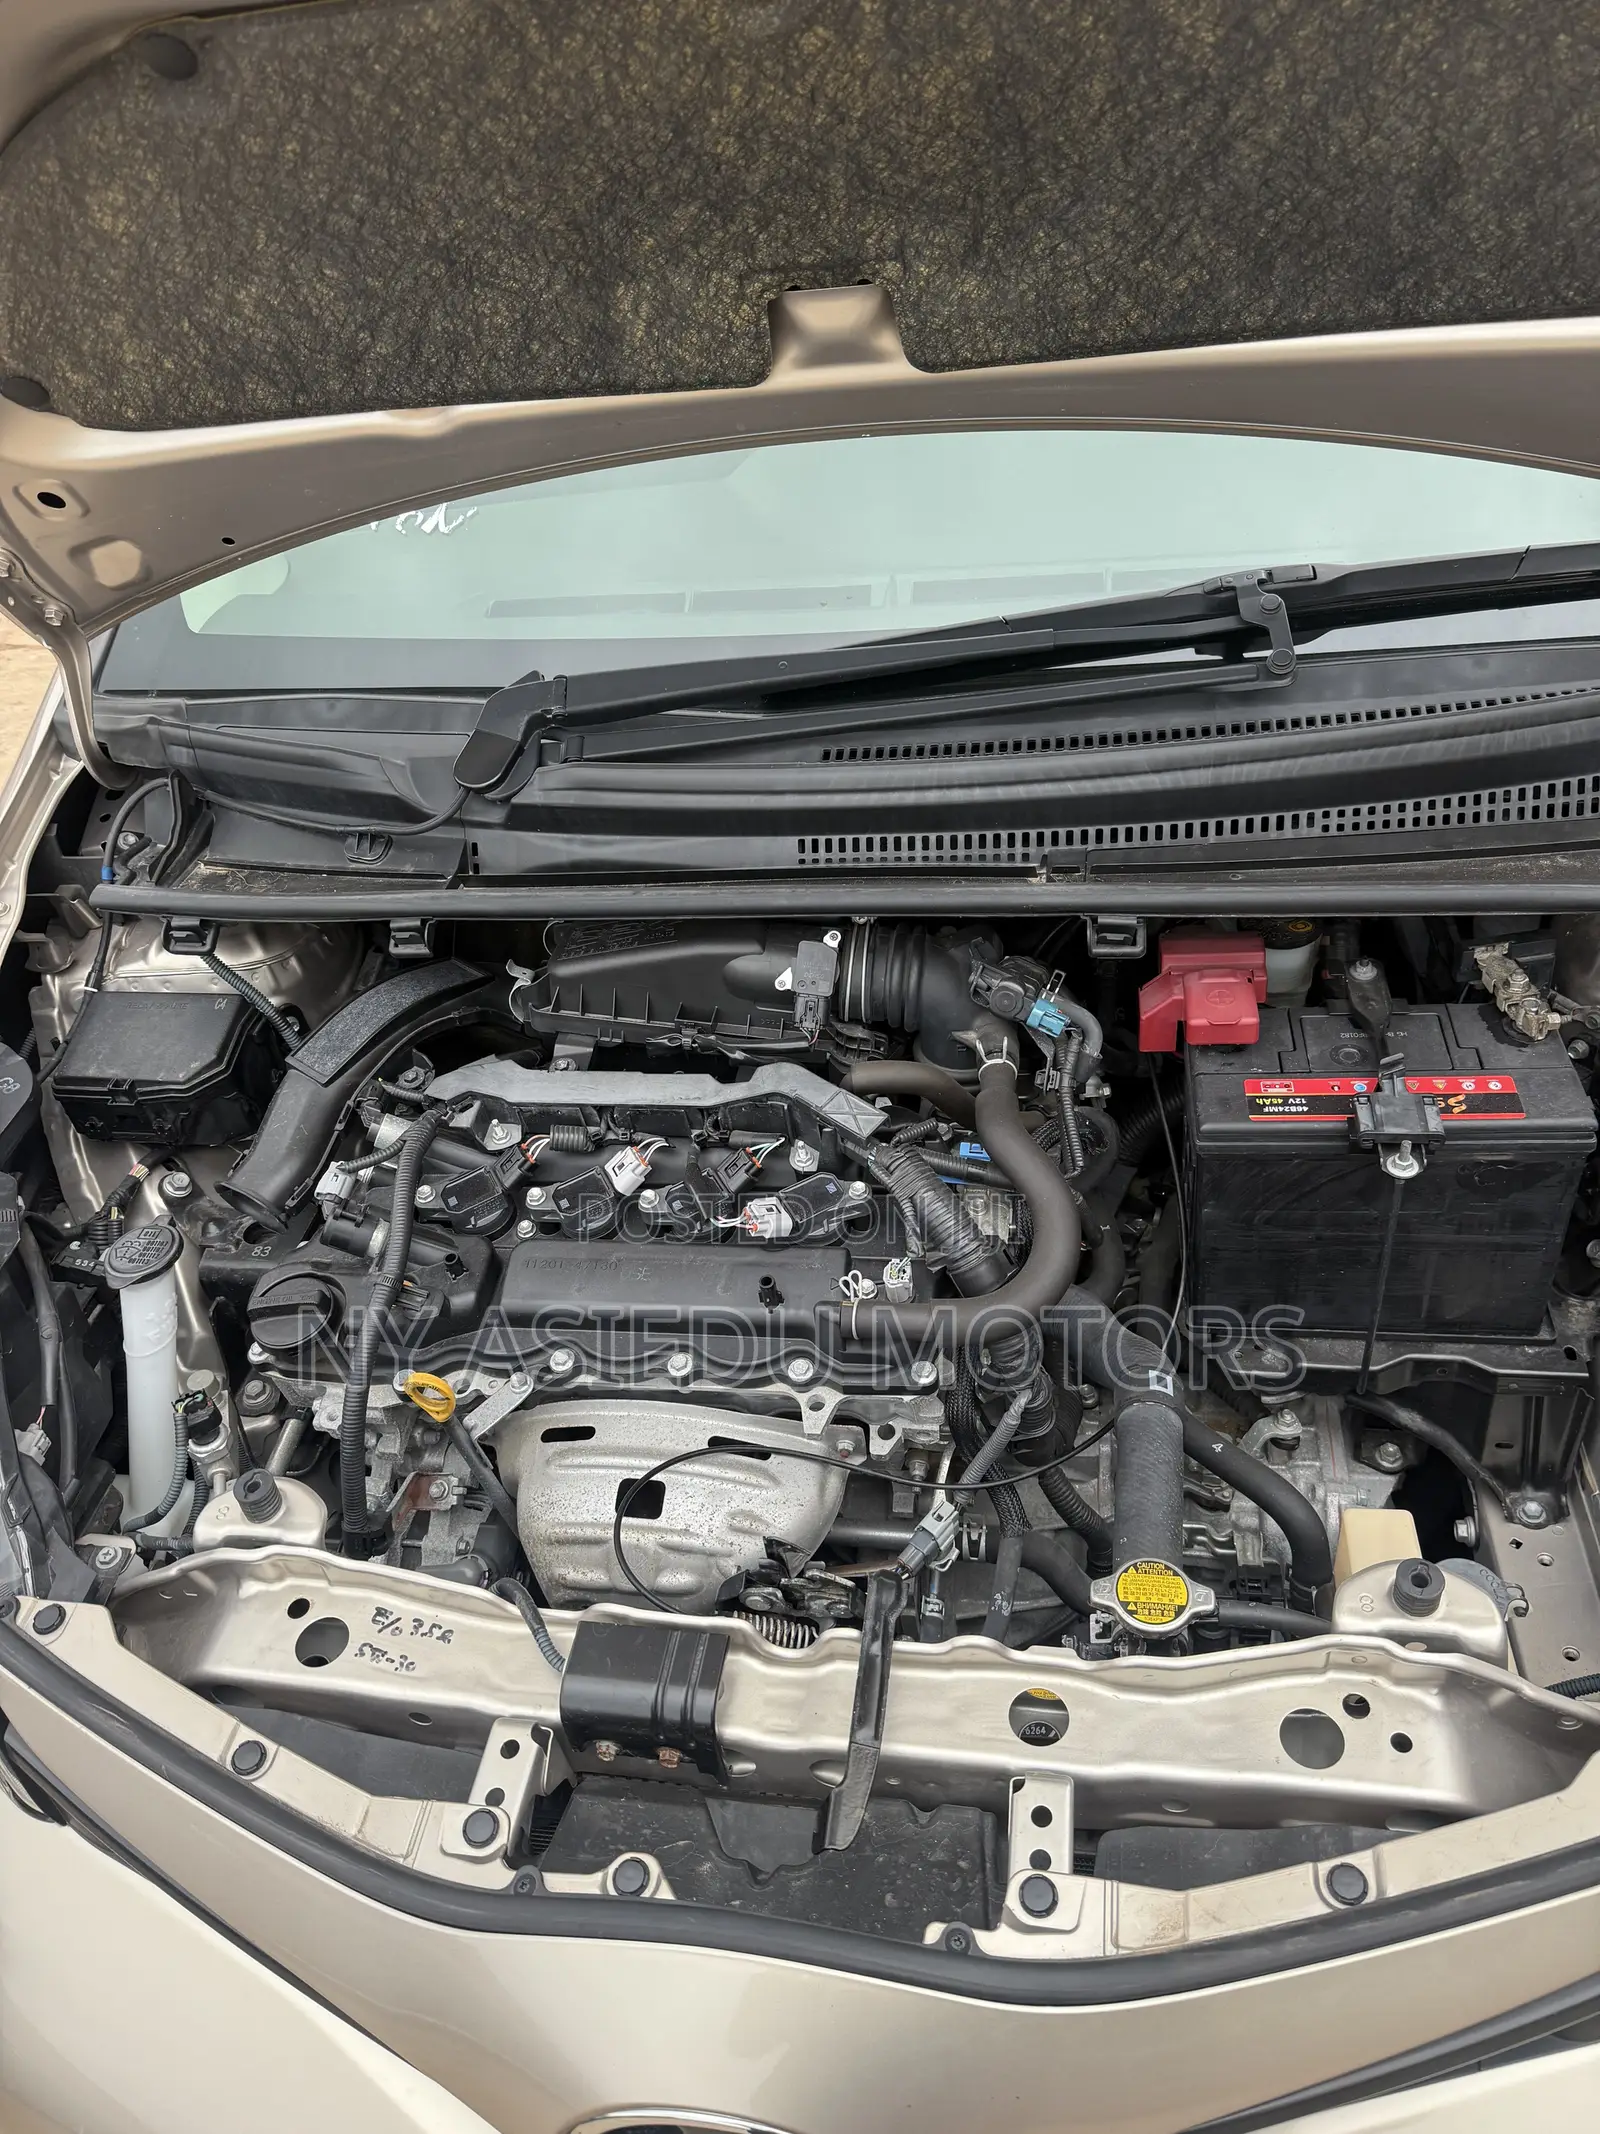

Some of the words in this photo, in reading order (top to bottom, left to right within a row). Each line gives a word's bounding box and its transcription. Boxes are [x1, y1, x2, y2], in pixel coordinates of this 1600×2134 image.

[1255, 1097, 1285, 1106] 45Ah
[1287, 1097, 1307, 1105] 12V
[251, 1245, 272, 1257] 83
[74, 1258, 95, 1268] 534
[1136, 1562, 1165, 1571] CAUTION
[1137, 1568, 1174, 1576] ATTENTION
